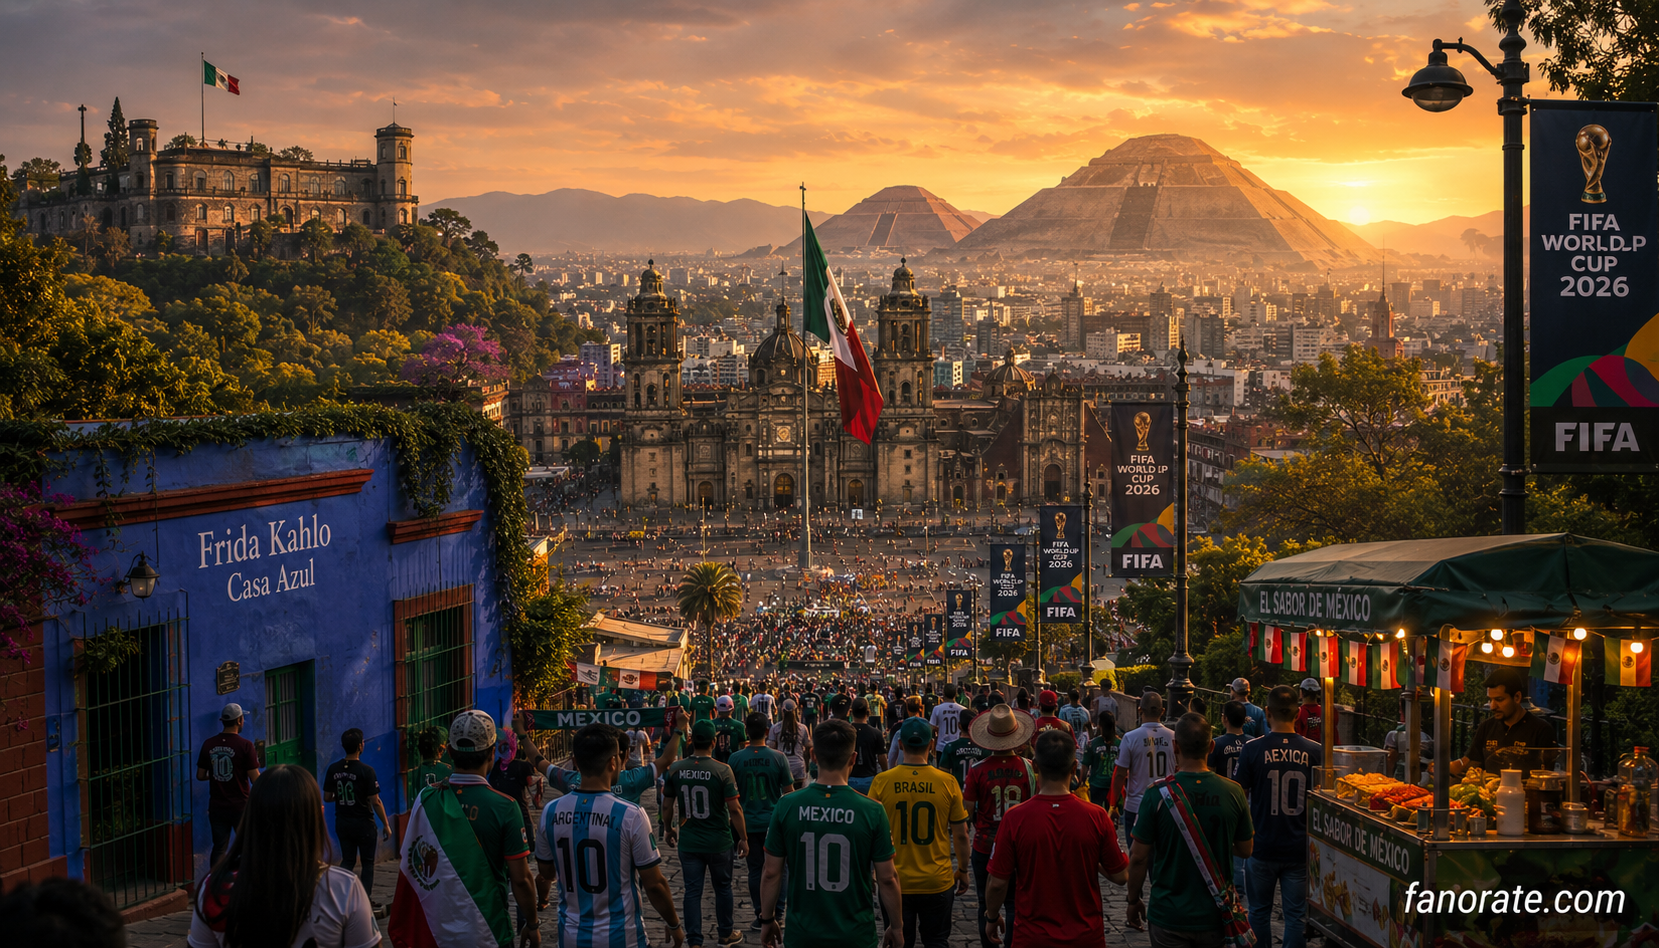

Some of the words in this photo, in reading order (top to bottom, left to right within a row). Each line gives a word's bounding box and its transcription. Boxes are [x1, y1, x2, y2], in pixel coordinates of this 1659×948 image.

[1569, 213, 1620, 231] FIFA
[1571, 255, 1618, 272] CUP
[1560, 275, 1629, 298] 2026
[1555, 422, 1640, 452] FIFA
[1130, 454, 1155, 464] FIFA
[1117, 465, 1156, 474] WORLD
[1131, 474, 1154, 483] CUP
[1125, 484, 1160, 495] 2026
[198, 523, 261, 569] Frida
[268, 513, 331, 557] Kahlo
[1049, 560, 1073, 568] 2026
[1122, 554, 1163, 569] FIFA
[227, 572, 270, 602] Casa
[276, 557, 316, 593] Azul
[1047, 606, 1076, 618] FIFA
[1260, 590, 1271, 614] EL
[1273, 590, 1306, 616] SABOR
[1308, 592, 1323, 618] DE
[1326, 586, 1371, 622] MÉXICO
[996, 628, 1020, 637] FIFA
[557, 710, 641, 727] MEXICO
[943, 716, 957, 735] 10
[1147, 751, 1166, 778] 10
[679, 769, 711, 781] MEXICO
[894, 781, 936, 794] BRASIL
[1267, 769, 1307, 816] 10
[680, 784, 710, 820] 10
[798, 805, 855, 825] MEXICO
[895, 801, 936, 846] 10
[1312, 807, 1322, 833] EL
[1323, 813, 1352, 848] SABOR
[1354, 826, 1367, 856] DE
[1369, 831, 1410, 875] MÉXICO
[557, 837, 607, 894] 10
[800, 831, 851, 893] 10
